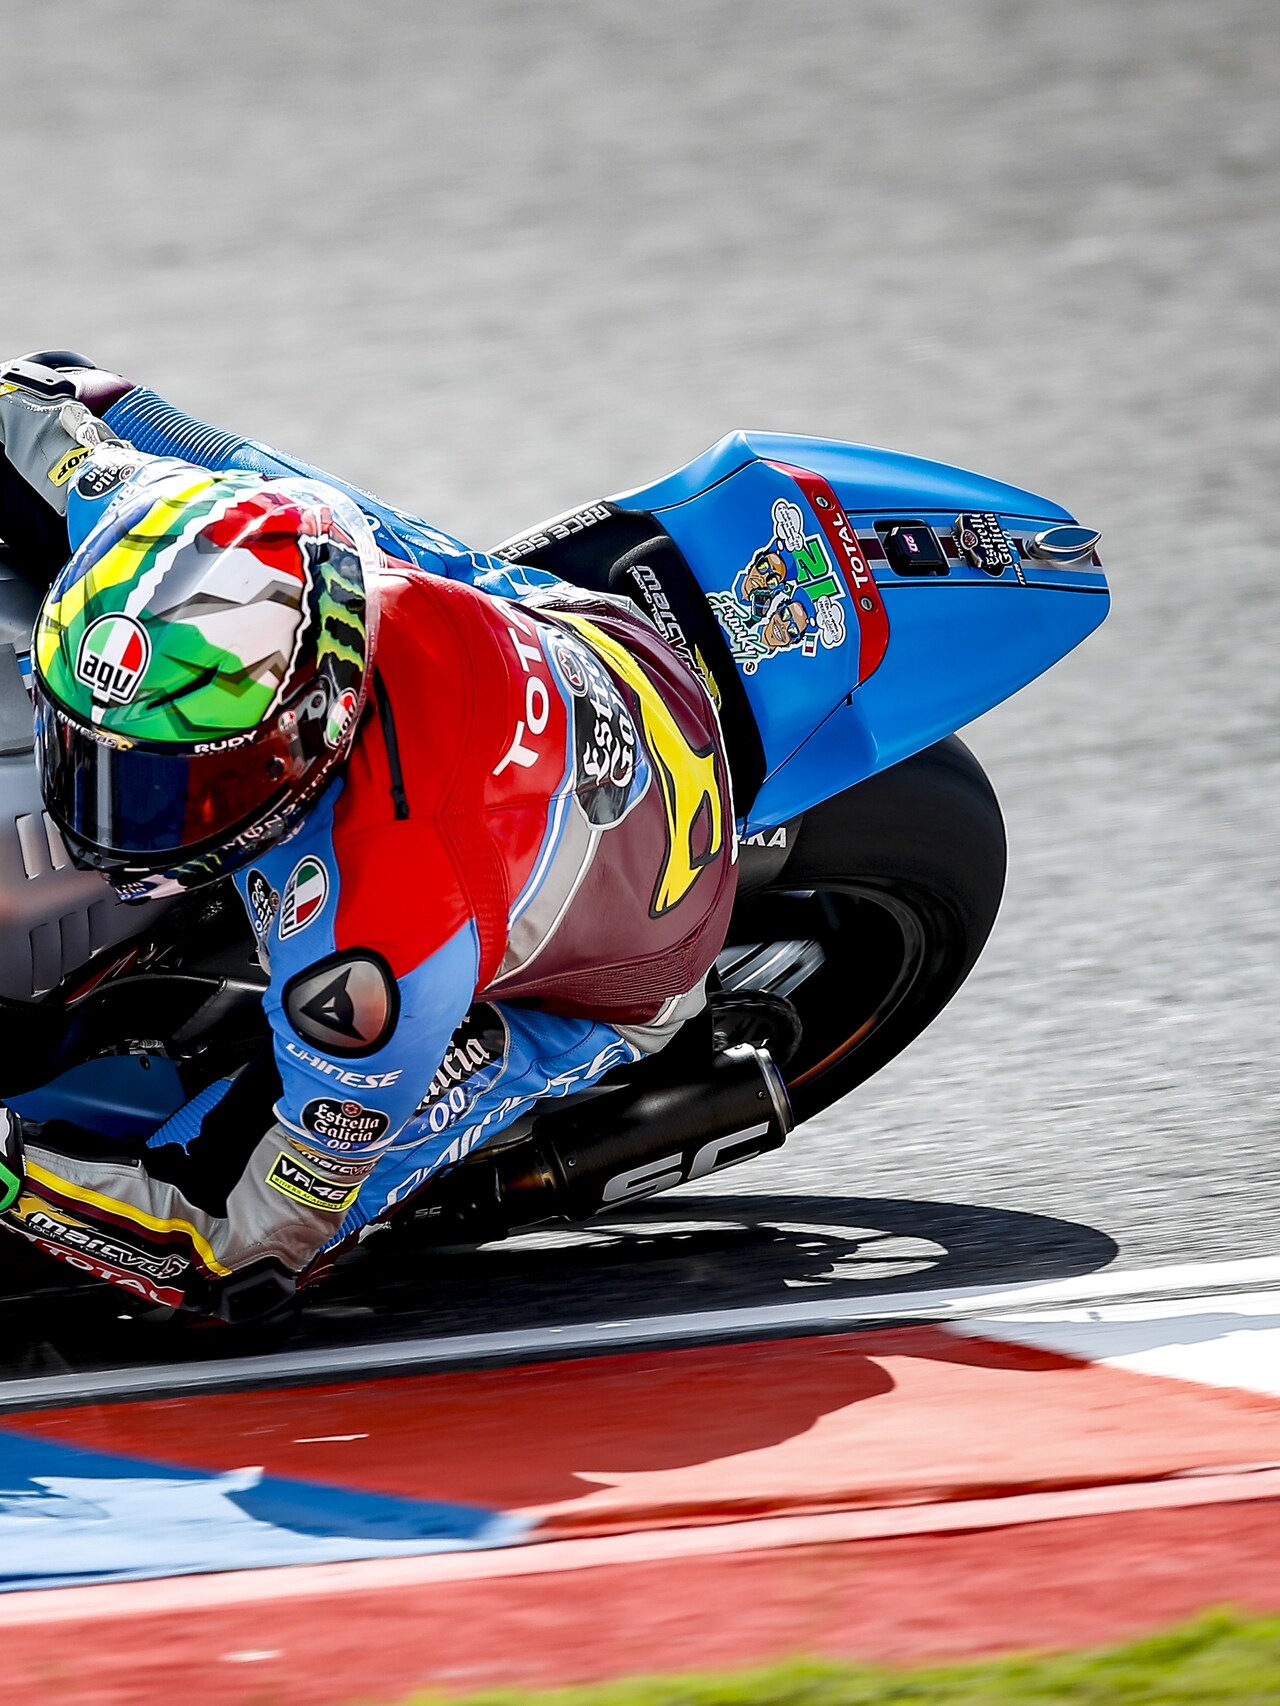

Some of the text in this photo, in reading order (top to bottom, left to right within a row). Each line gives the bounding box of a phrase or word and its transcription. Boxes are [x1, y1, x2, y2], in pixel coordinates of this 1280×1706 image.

[548, 505, 612, 540] RACE
[793, 534, 846, 601] 21
[833, 512, 870, 589] TOTAL
[82, 651, 135, 698] agv
[194, 730, 258, 755] RUDY
[314, 1103, 380, 1129] Estrella
[314, 1119, 373, 1142] Galicia
[602, 1121, 769, 1202] SC
[42, 1243, 171, 1307] TOTAL
